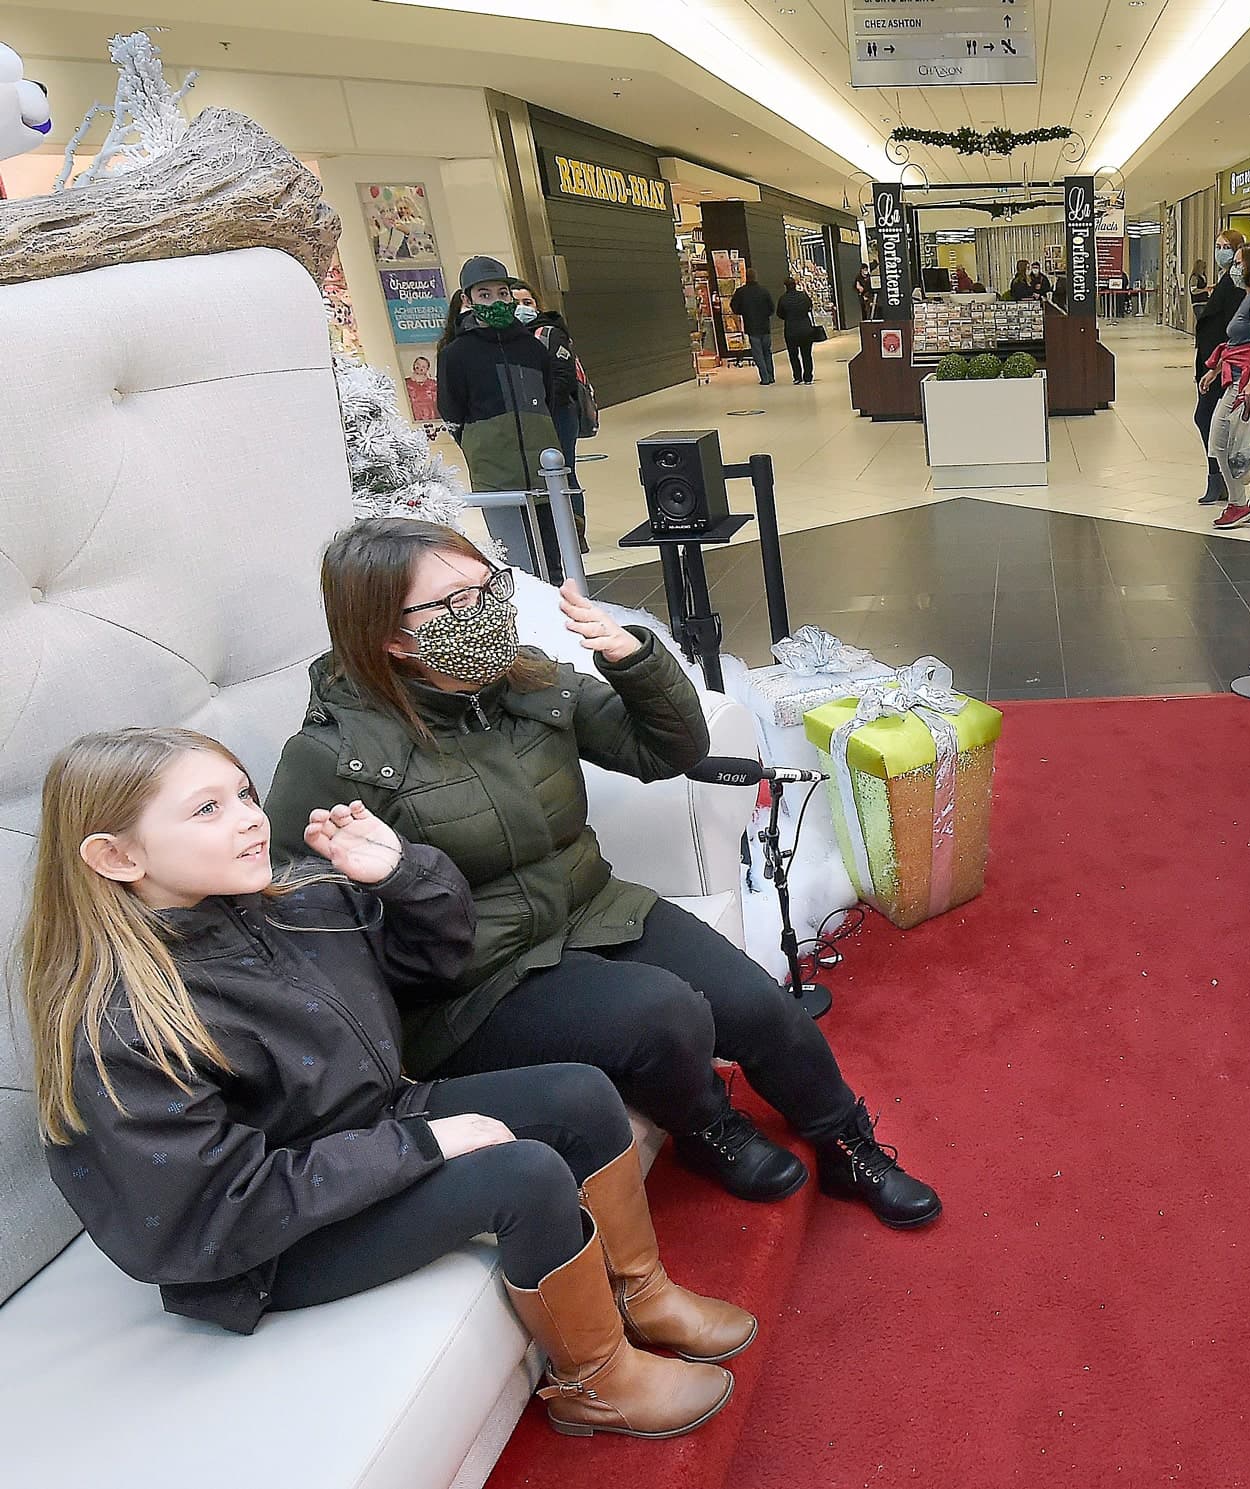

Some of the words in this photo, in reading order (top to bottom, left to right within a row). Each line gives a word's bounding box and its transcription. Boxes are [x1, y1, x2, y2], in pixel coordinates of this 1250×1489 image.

[864, 19, 886, 28] CHEZ
[888, 19, 922, 28] ASHTON
[554, 155, 667, 210] RENAUD-BRAY
[878, 192, 901, 227] La
[1069, 186, 1092, 221] La
[389, 273, 429, 289] Cheveux
[883, 232, 904, 306] Forfaiterie
[1072, 227, 1090, 302] Forfaiterie
[400, 290, 432, 303] Bijoux
[398, 319, 446, 329] GRATUIT
